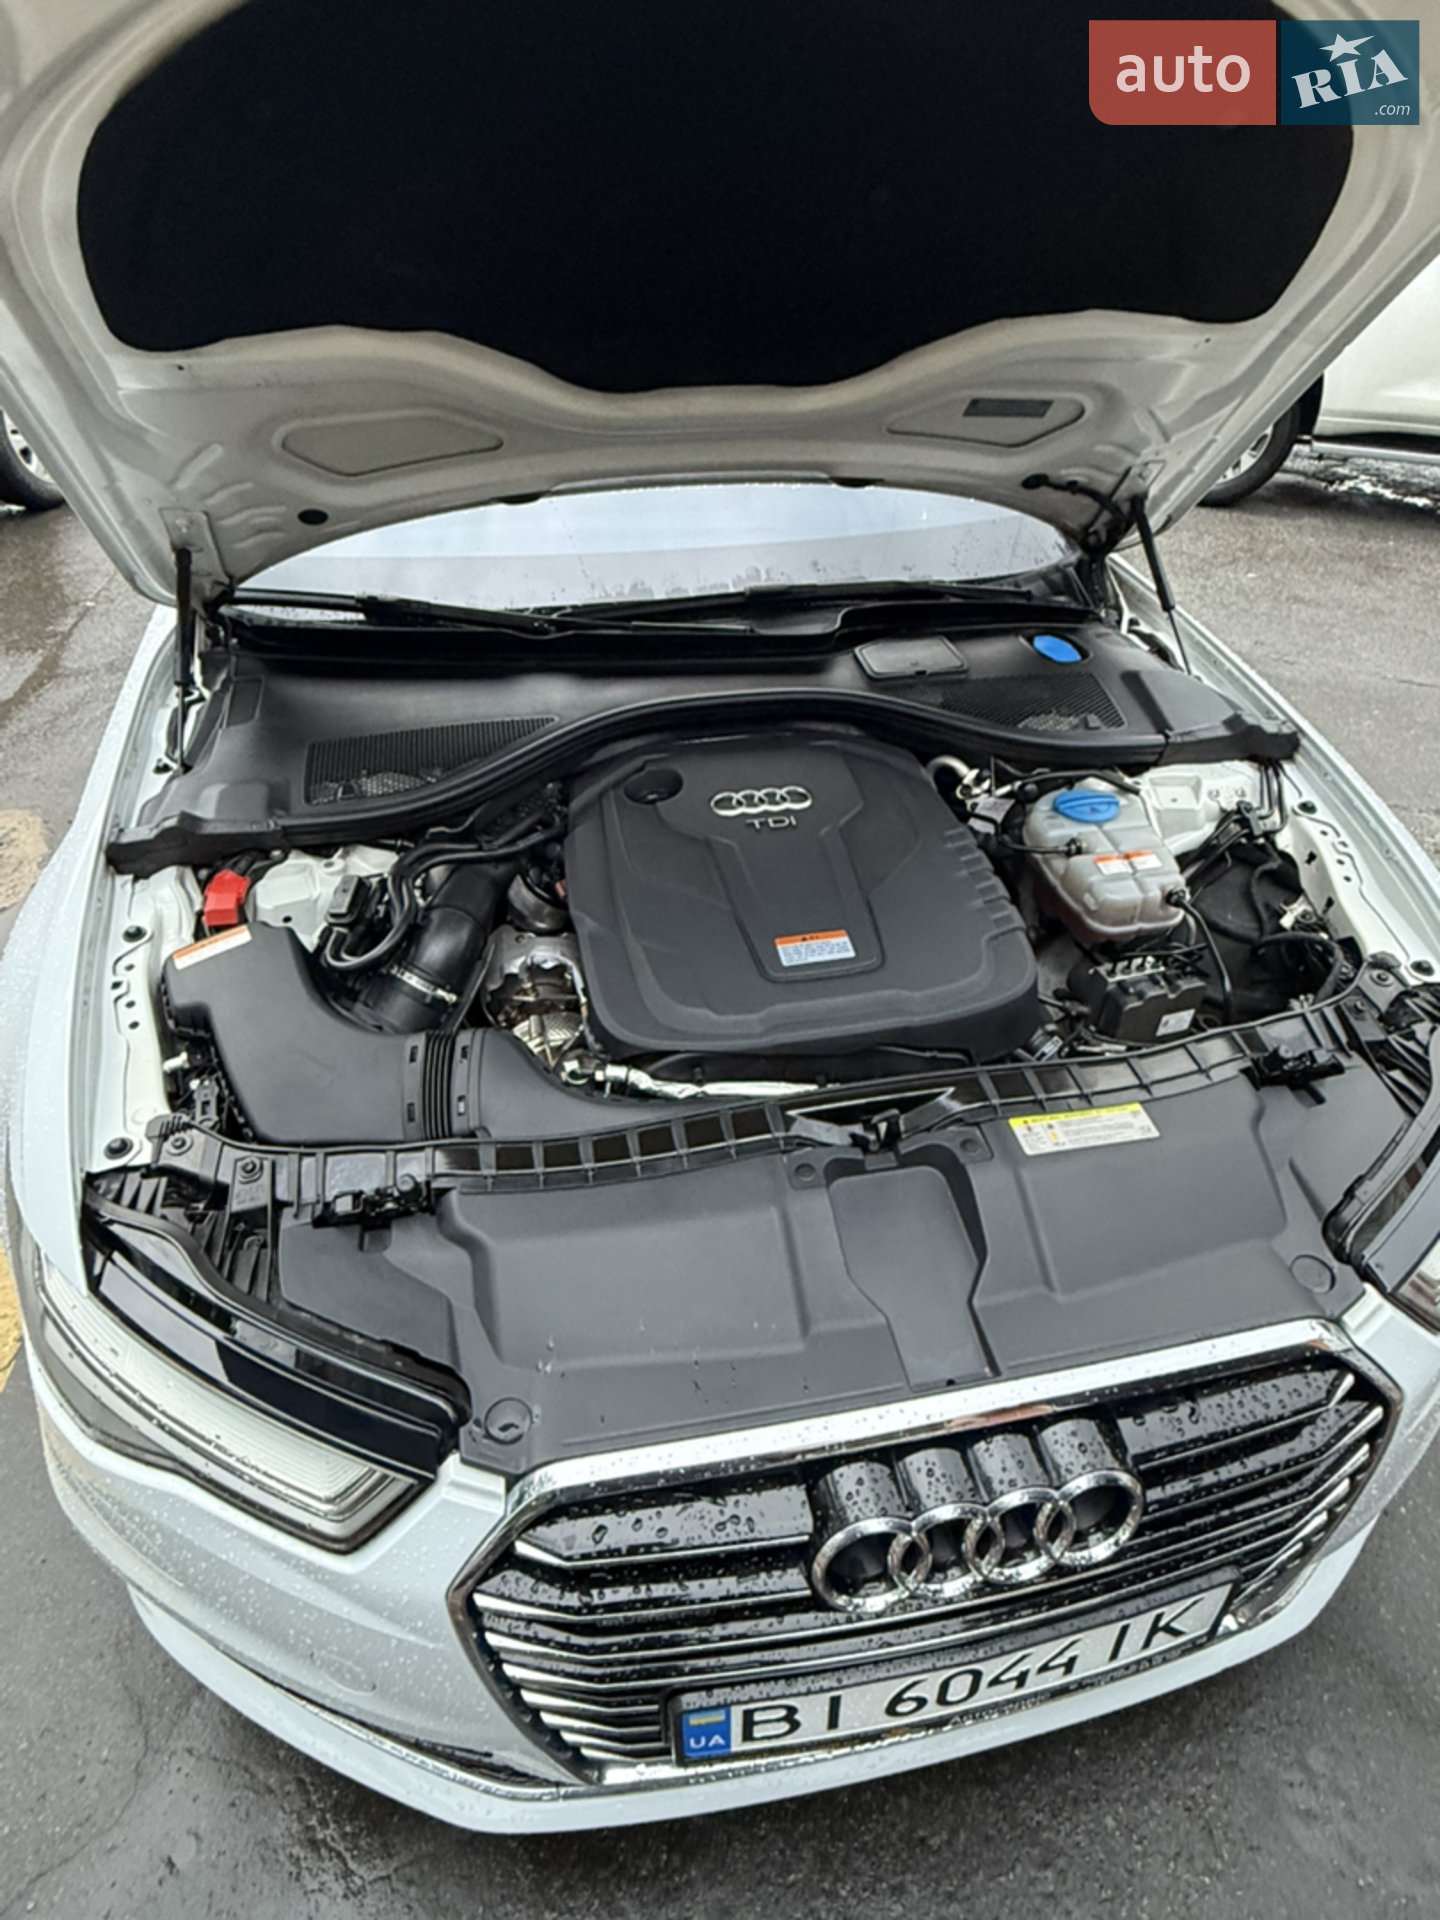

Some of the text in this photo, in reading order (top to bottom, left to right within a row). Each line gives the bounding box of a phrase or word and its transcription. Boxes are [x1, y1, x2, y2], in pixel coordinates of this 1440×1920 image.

[745, 815, 798, 830] TDI
[742, 1694, 843, 1743] BI
[884, 1637, 1083, 1717] 6044
[1108, 1596, 1205, 1663] IK
[689, 1734, 726, 1749] UA
